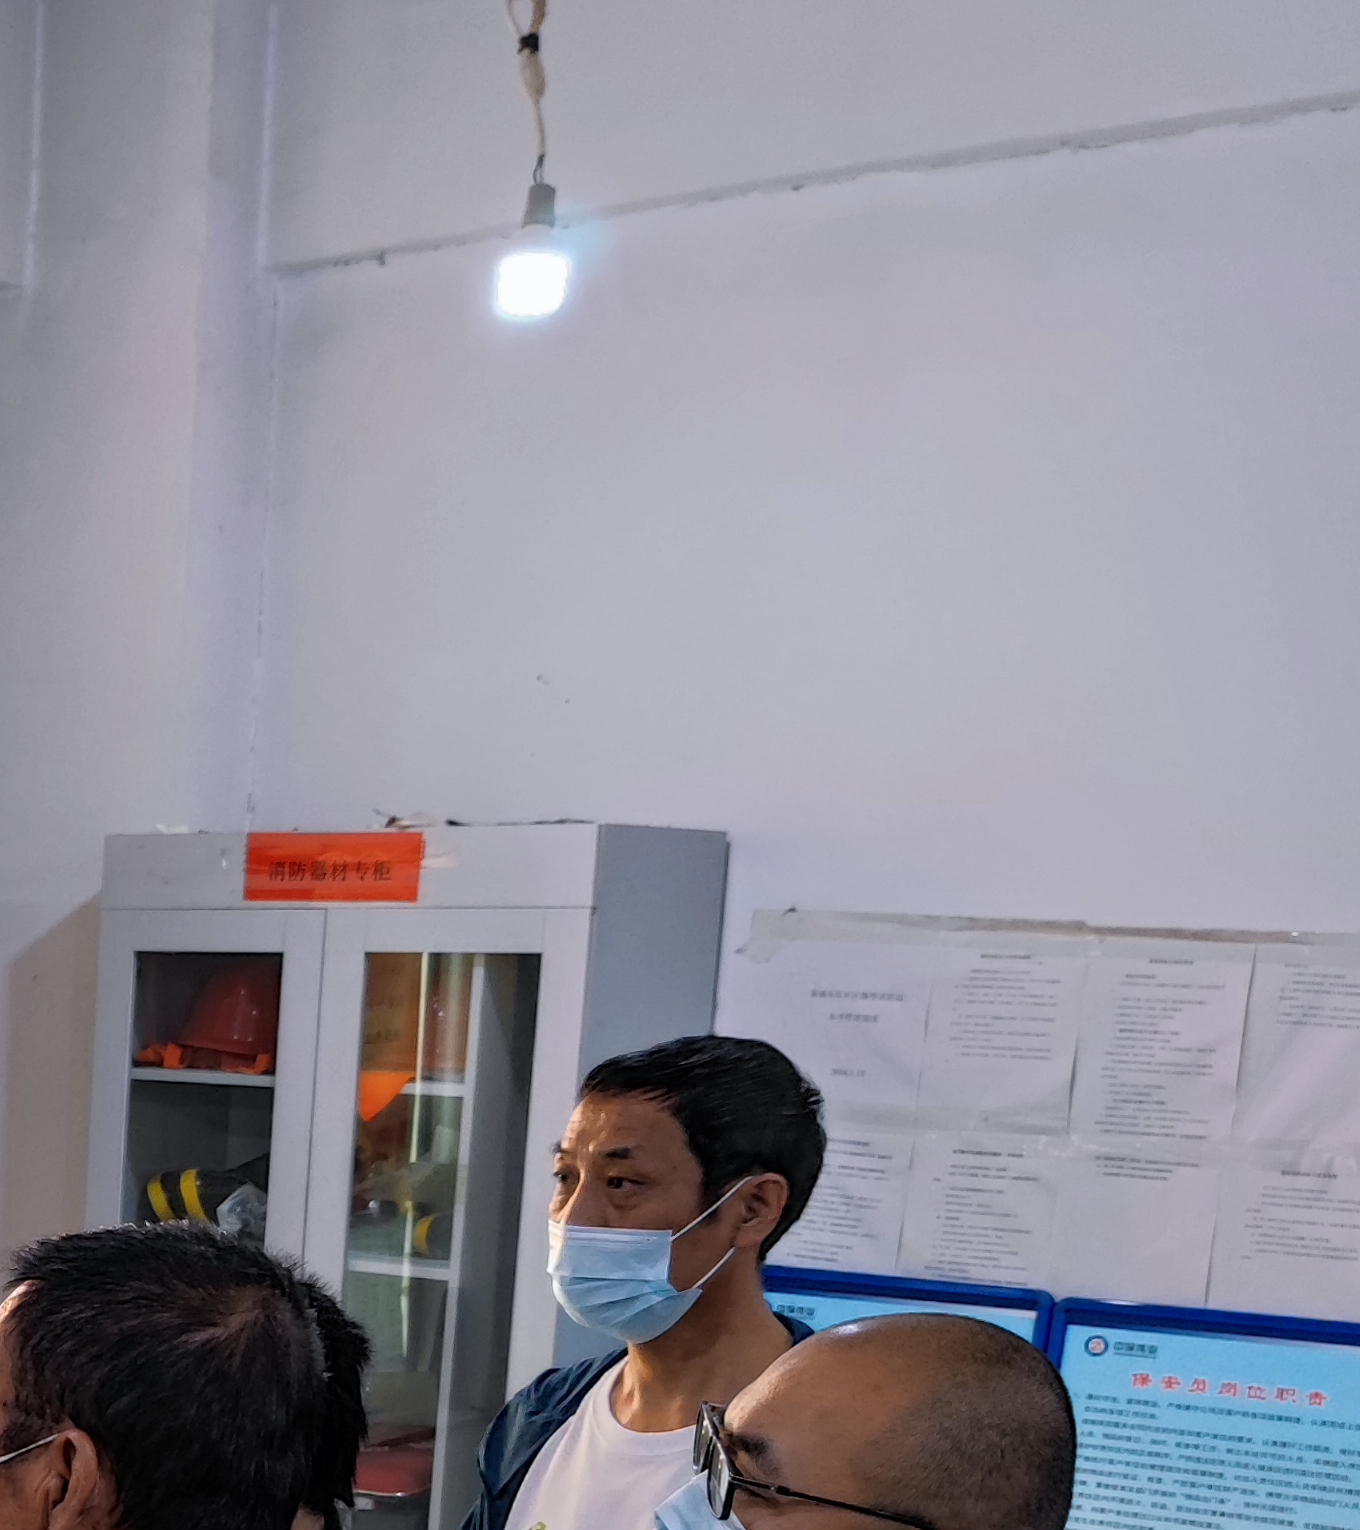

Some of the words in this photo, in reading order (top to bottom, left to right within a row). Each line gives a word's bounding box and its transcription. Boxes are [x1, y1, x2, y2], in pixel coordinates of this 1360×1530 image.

[1131, 1373, 1328, 1408] 保安员岗位职责
